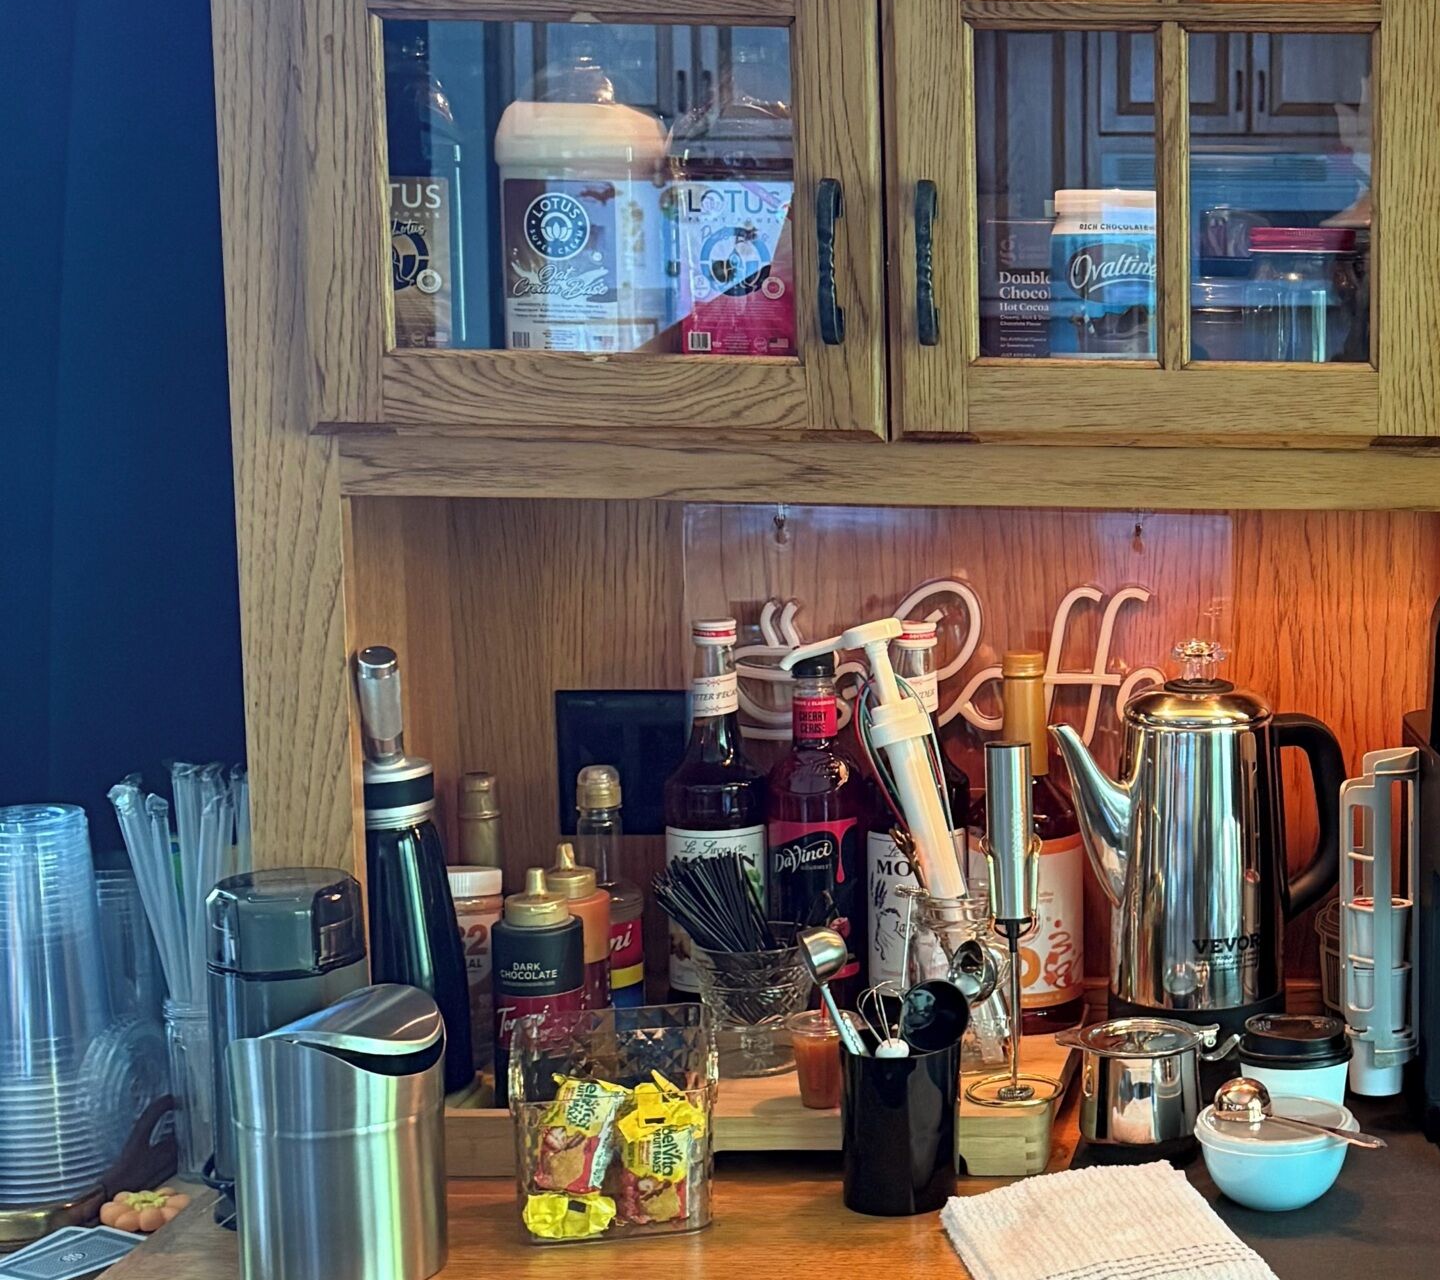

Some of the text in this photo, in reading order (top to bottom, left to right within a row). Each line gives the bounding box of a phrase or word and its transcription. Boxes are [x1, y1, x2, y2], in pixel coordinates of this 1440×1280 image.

[532, 197, 581, 219] LOTUS
[687, 188, 782, 215] LOTUS
[392, 218, 426, 236] Lotus
[1079, 223, 1149, 231] RICH CHOCOLATE
[529, 227, 552, 254] SUPER
[538, 264, 575, 284] Oat
[513, 275, 609, 299] Cream Base
[999, 302, 1049, 312] Hot Cocoa
[798, 710, 827, 722] CHERRY
[799, 722, 827, 734] CERISE
[680, 839, 696, 855] Le
[883, 840, 899, 858] Le
[774, 839, 834, 874] DaVinci
[1191, 932, 1262, 955] VEVOR
[499, 968, 559, 981] CHOCOLATE
[512, 961, 541, 971] DARK
[661, 1124, 684, 1178] belVita
